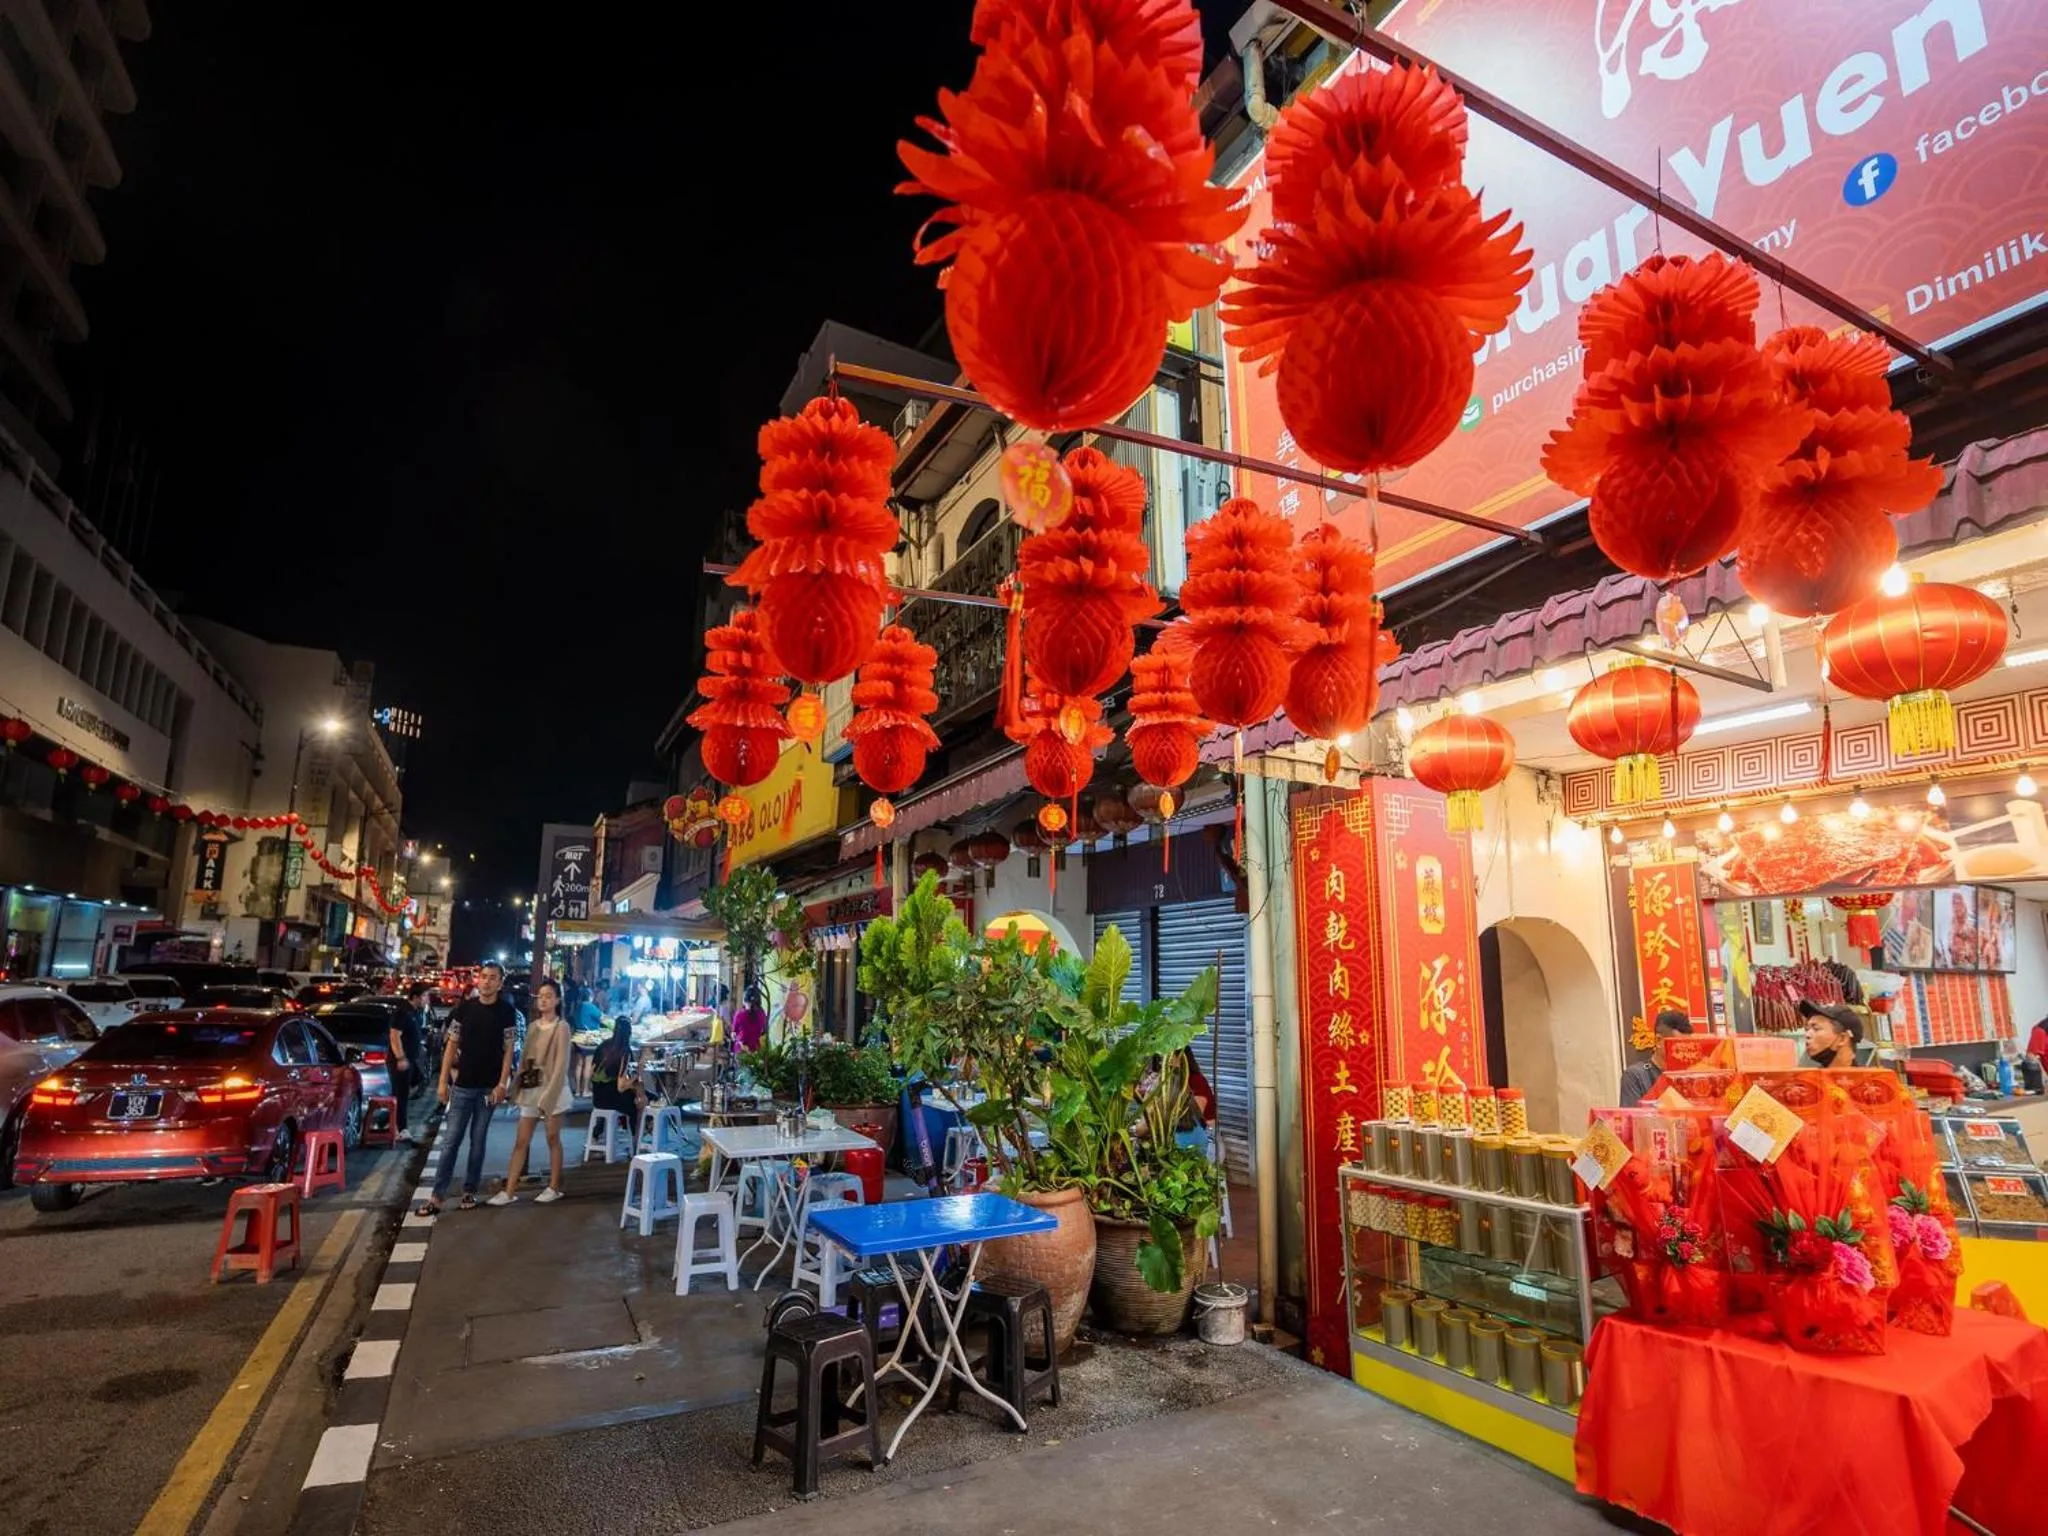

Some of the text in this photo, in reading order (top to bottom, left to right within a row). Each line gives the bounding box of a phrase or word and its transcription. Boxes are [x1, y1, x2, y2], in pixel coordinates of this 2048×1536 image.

[1473, 206, 1649, 367] uar
[1906, 232, 2048, 315] Dimilik
[565, 883, 590, 893] 200m
